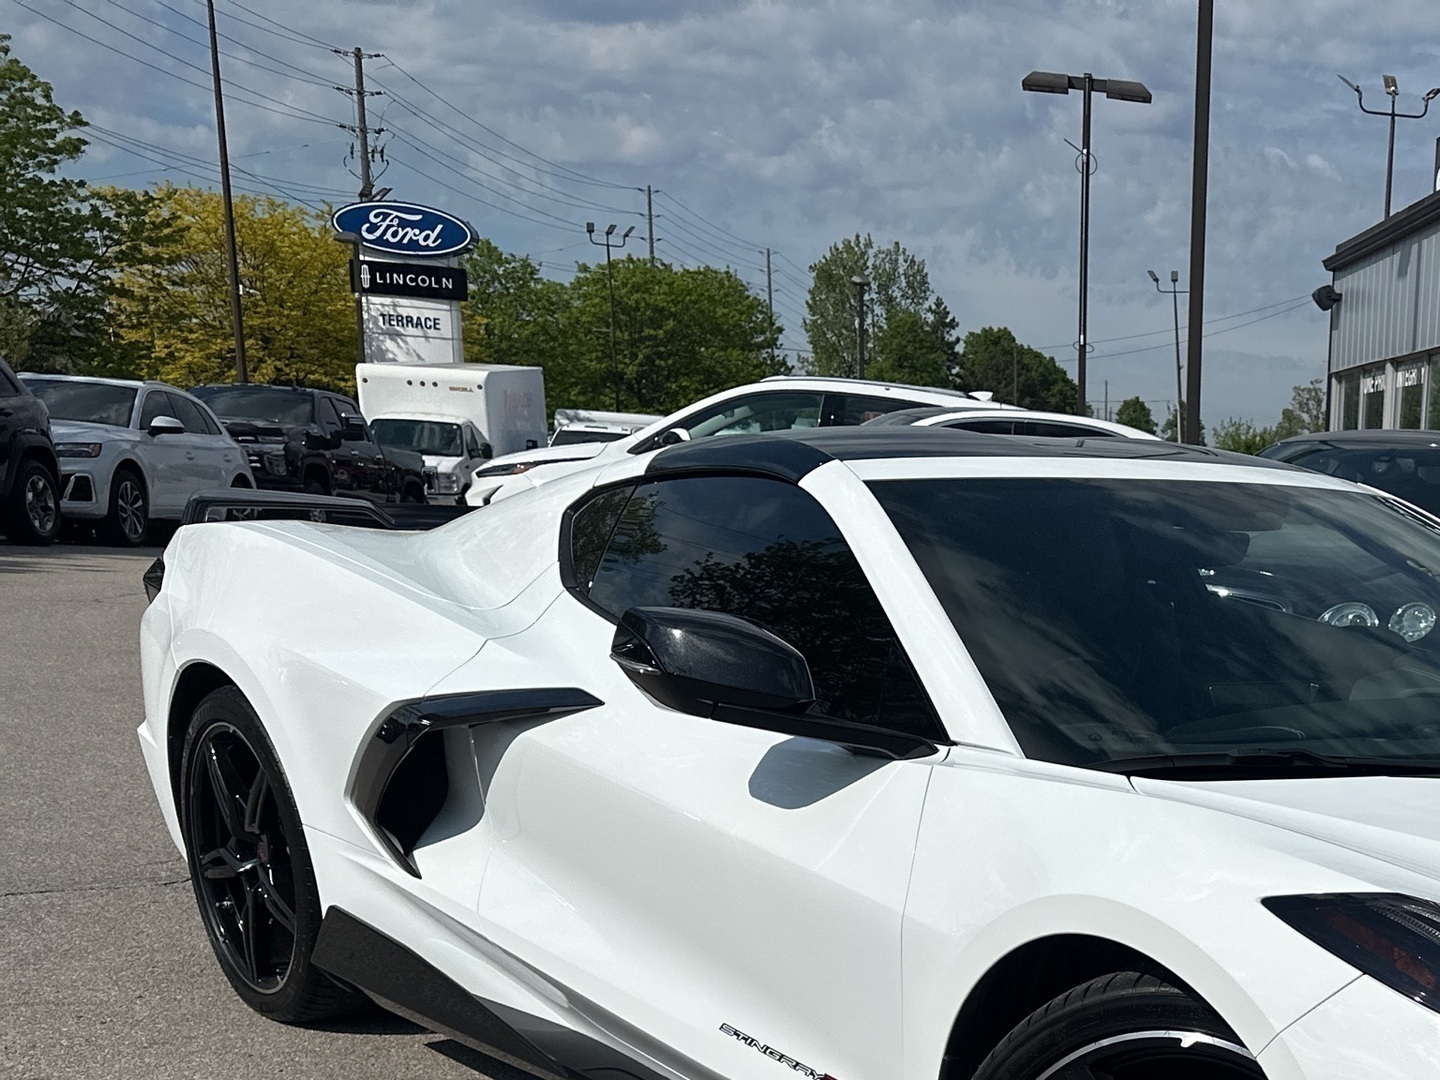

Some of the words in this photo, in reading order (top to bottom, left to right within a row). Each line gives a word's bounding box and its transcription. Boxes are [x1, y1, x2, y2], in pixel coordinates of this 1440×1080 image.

[361, 208, 443, 247] Ford
[376, 272, 453, 289] LINCOLN
[380, 313, 441, 331] TERRACE
